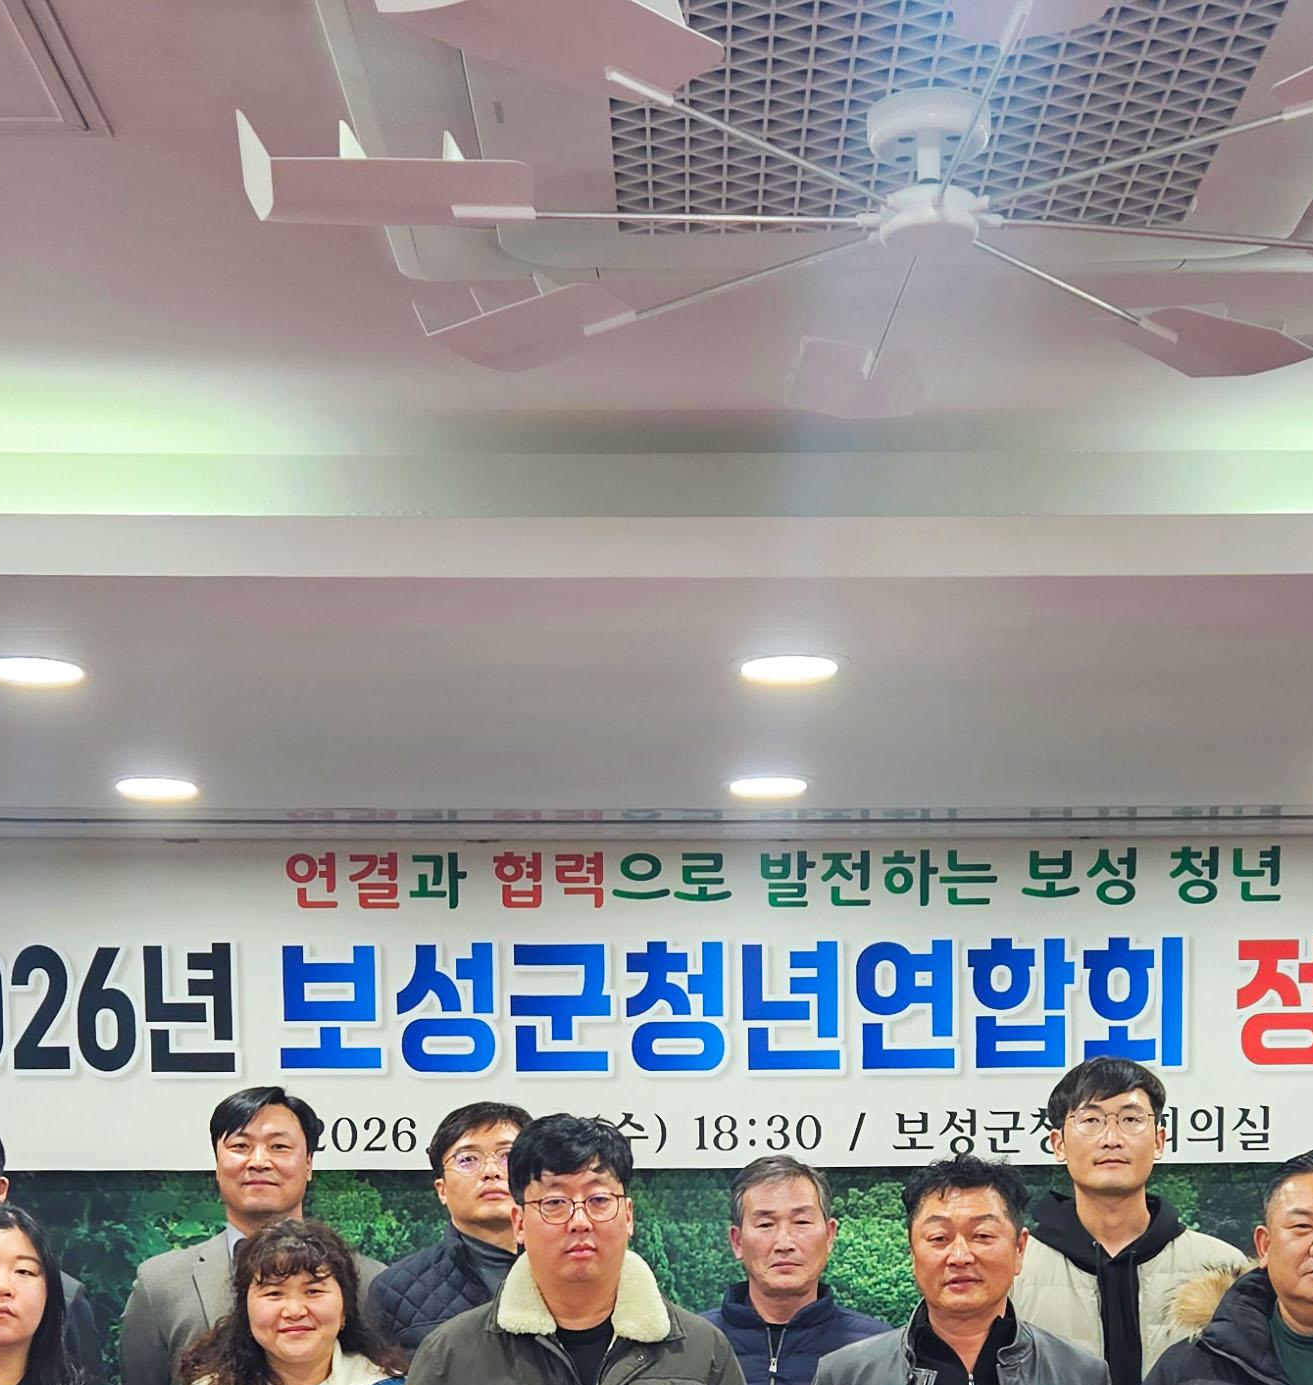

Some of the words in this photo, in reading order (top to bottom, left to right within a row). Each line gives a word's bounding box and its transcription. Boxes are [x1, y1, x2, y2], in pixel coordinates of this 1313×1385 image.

[285, 850, 467, 912] 연결과
[494, 850, 732, 910] 협력으로
[759, 848, 997, 907] 발전하는
[1021, 847, 1138, 903] 보성
[1168, 844, 1283, 904] 청년
[280, 935, 1185, 1076] 보성군청년연합회
[694, 1113, 823, 1152] 18:30
